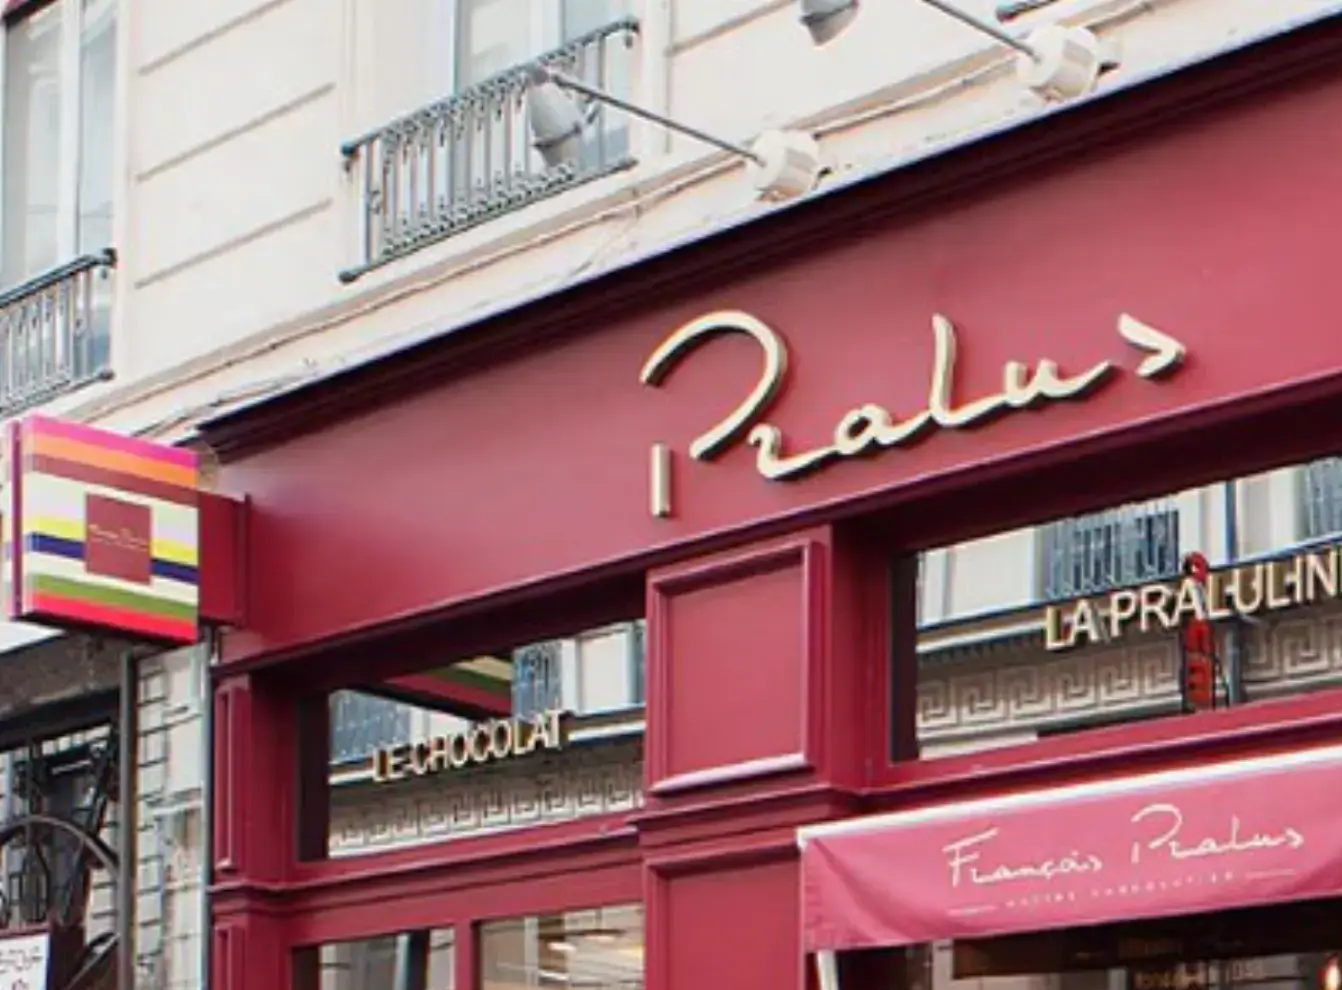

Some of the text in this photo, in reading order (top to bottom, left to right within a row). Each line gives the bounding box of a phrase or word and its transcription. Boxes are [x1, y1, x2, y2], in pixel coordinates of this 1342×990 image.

[641, 309, 1186, 517] Pralus
[1044, 599, 1099, 651] LA
[372, 708, 565, 783] LE CHOCOLAT
[1130, 803, 1304, 865] Pralus
